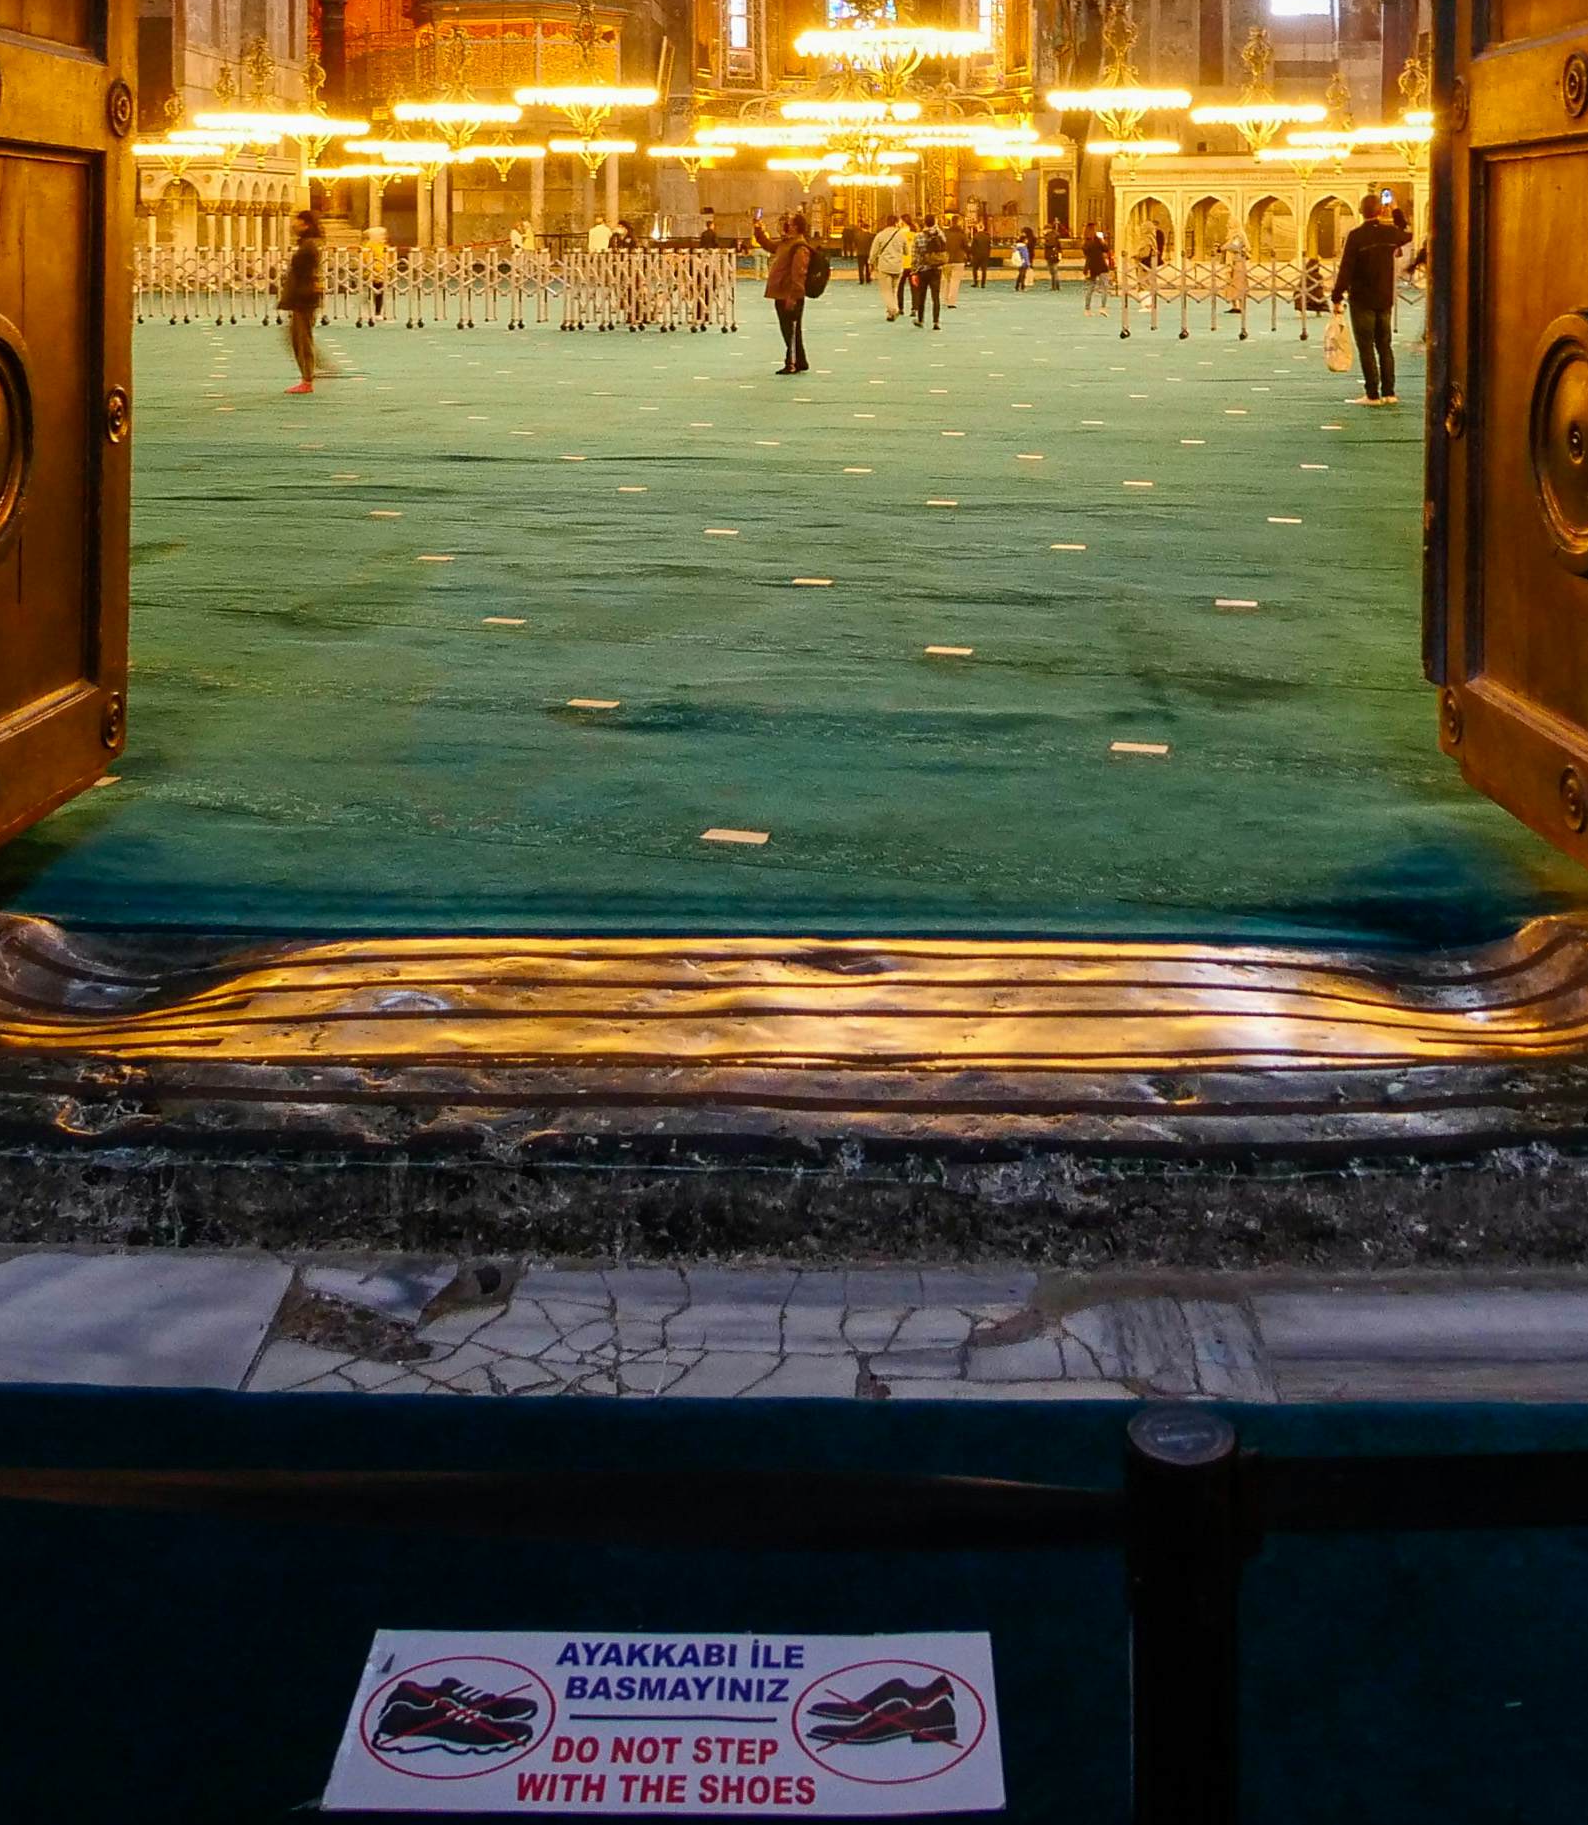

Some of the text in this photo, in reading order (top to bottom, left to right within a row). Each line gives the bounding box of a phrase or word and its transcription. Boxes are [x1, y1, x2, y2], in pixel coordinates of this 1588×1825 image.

[556, 1639, 804, 1669] AYAKKABI İLE
[564, 1675, 790, 1703] BASMAYINIZ
[551, 1736, 779, 1765] DO NOT STEP
[516, 1773, 817, 1805] WITH THE SHOES
